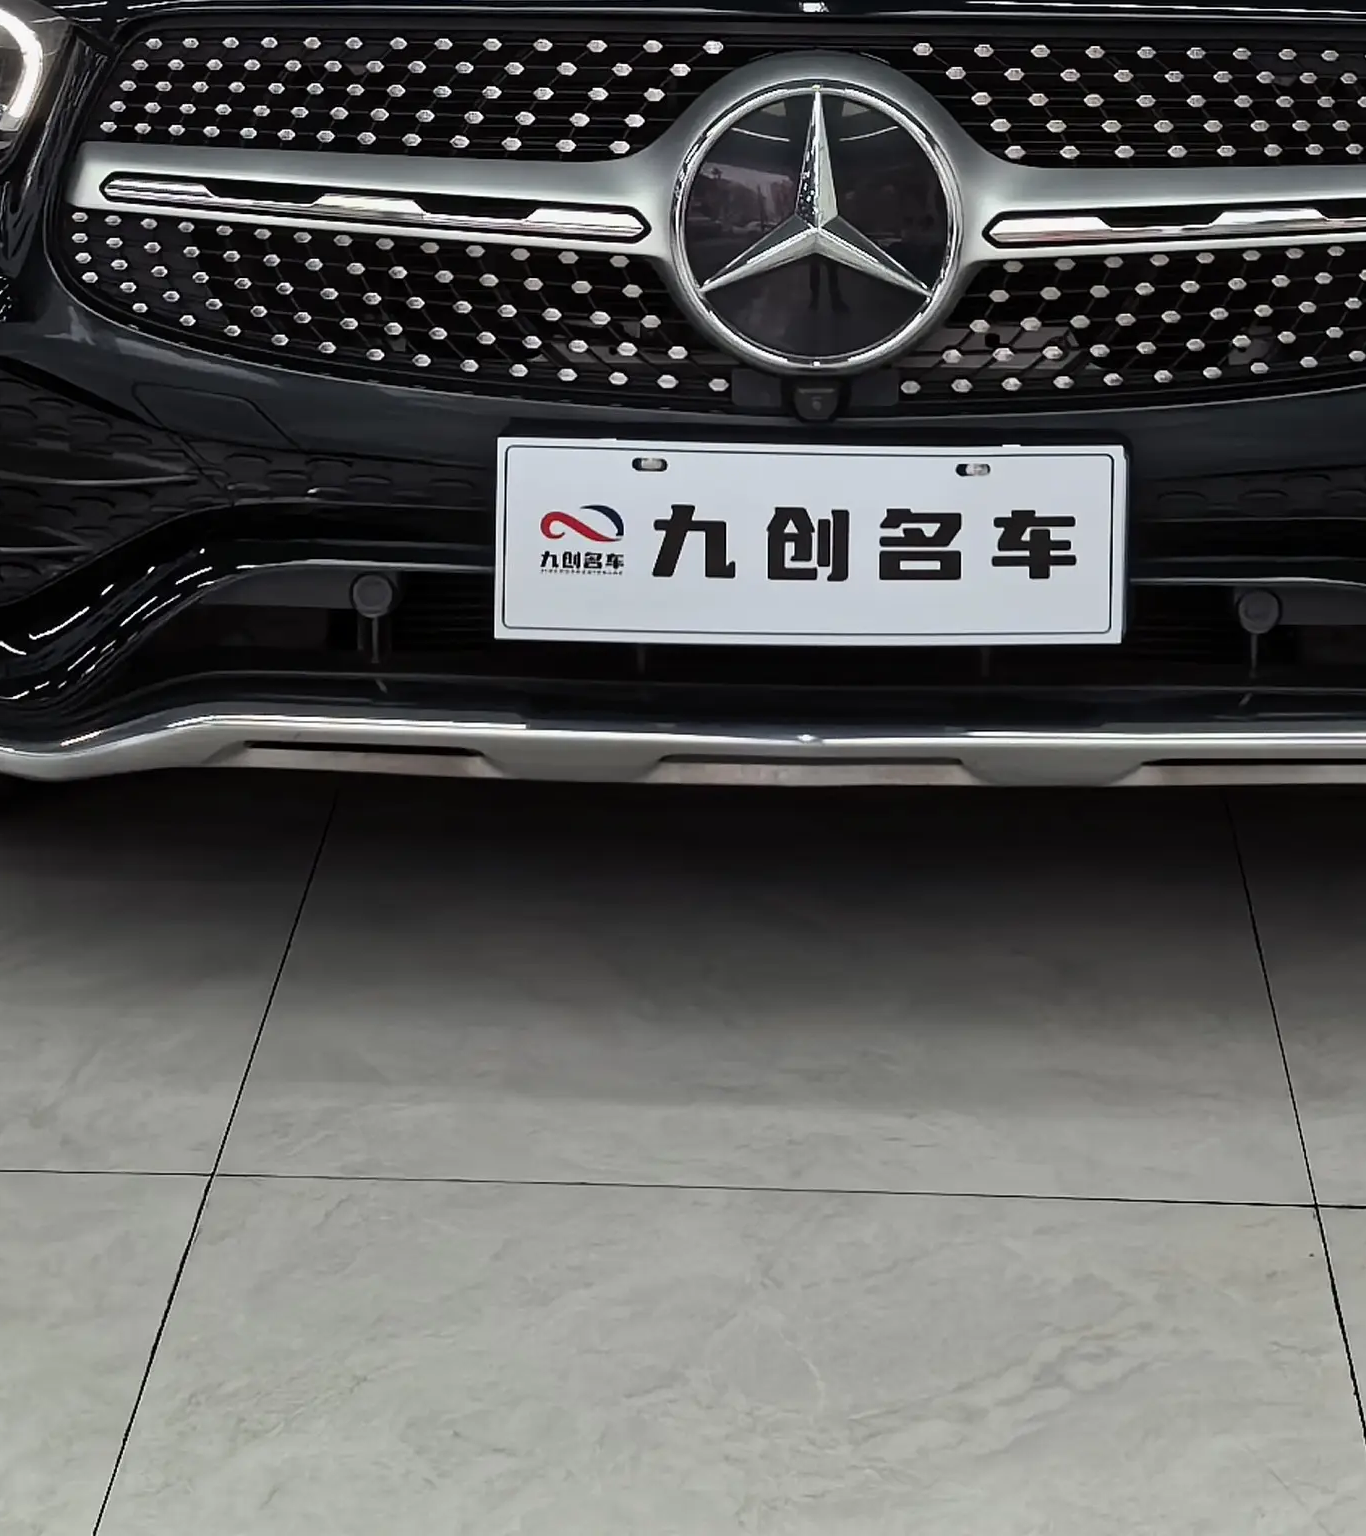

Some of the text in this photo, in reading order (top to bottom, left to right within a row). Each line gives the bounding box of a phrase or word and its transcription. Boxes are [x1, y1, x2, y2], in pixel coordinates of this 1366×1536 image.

[540, 550, 625, 570] 九创名车
[651, 503, 1077, 582] 九创名车
